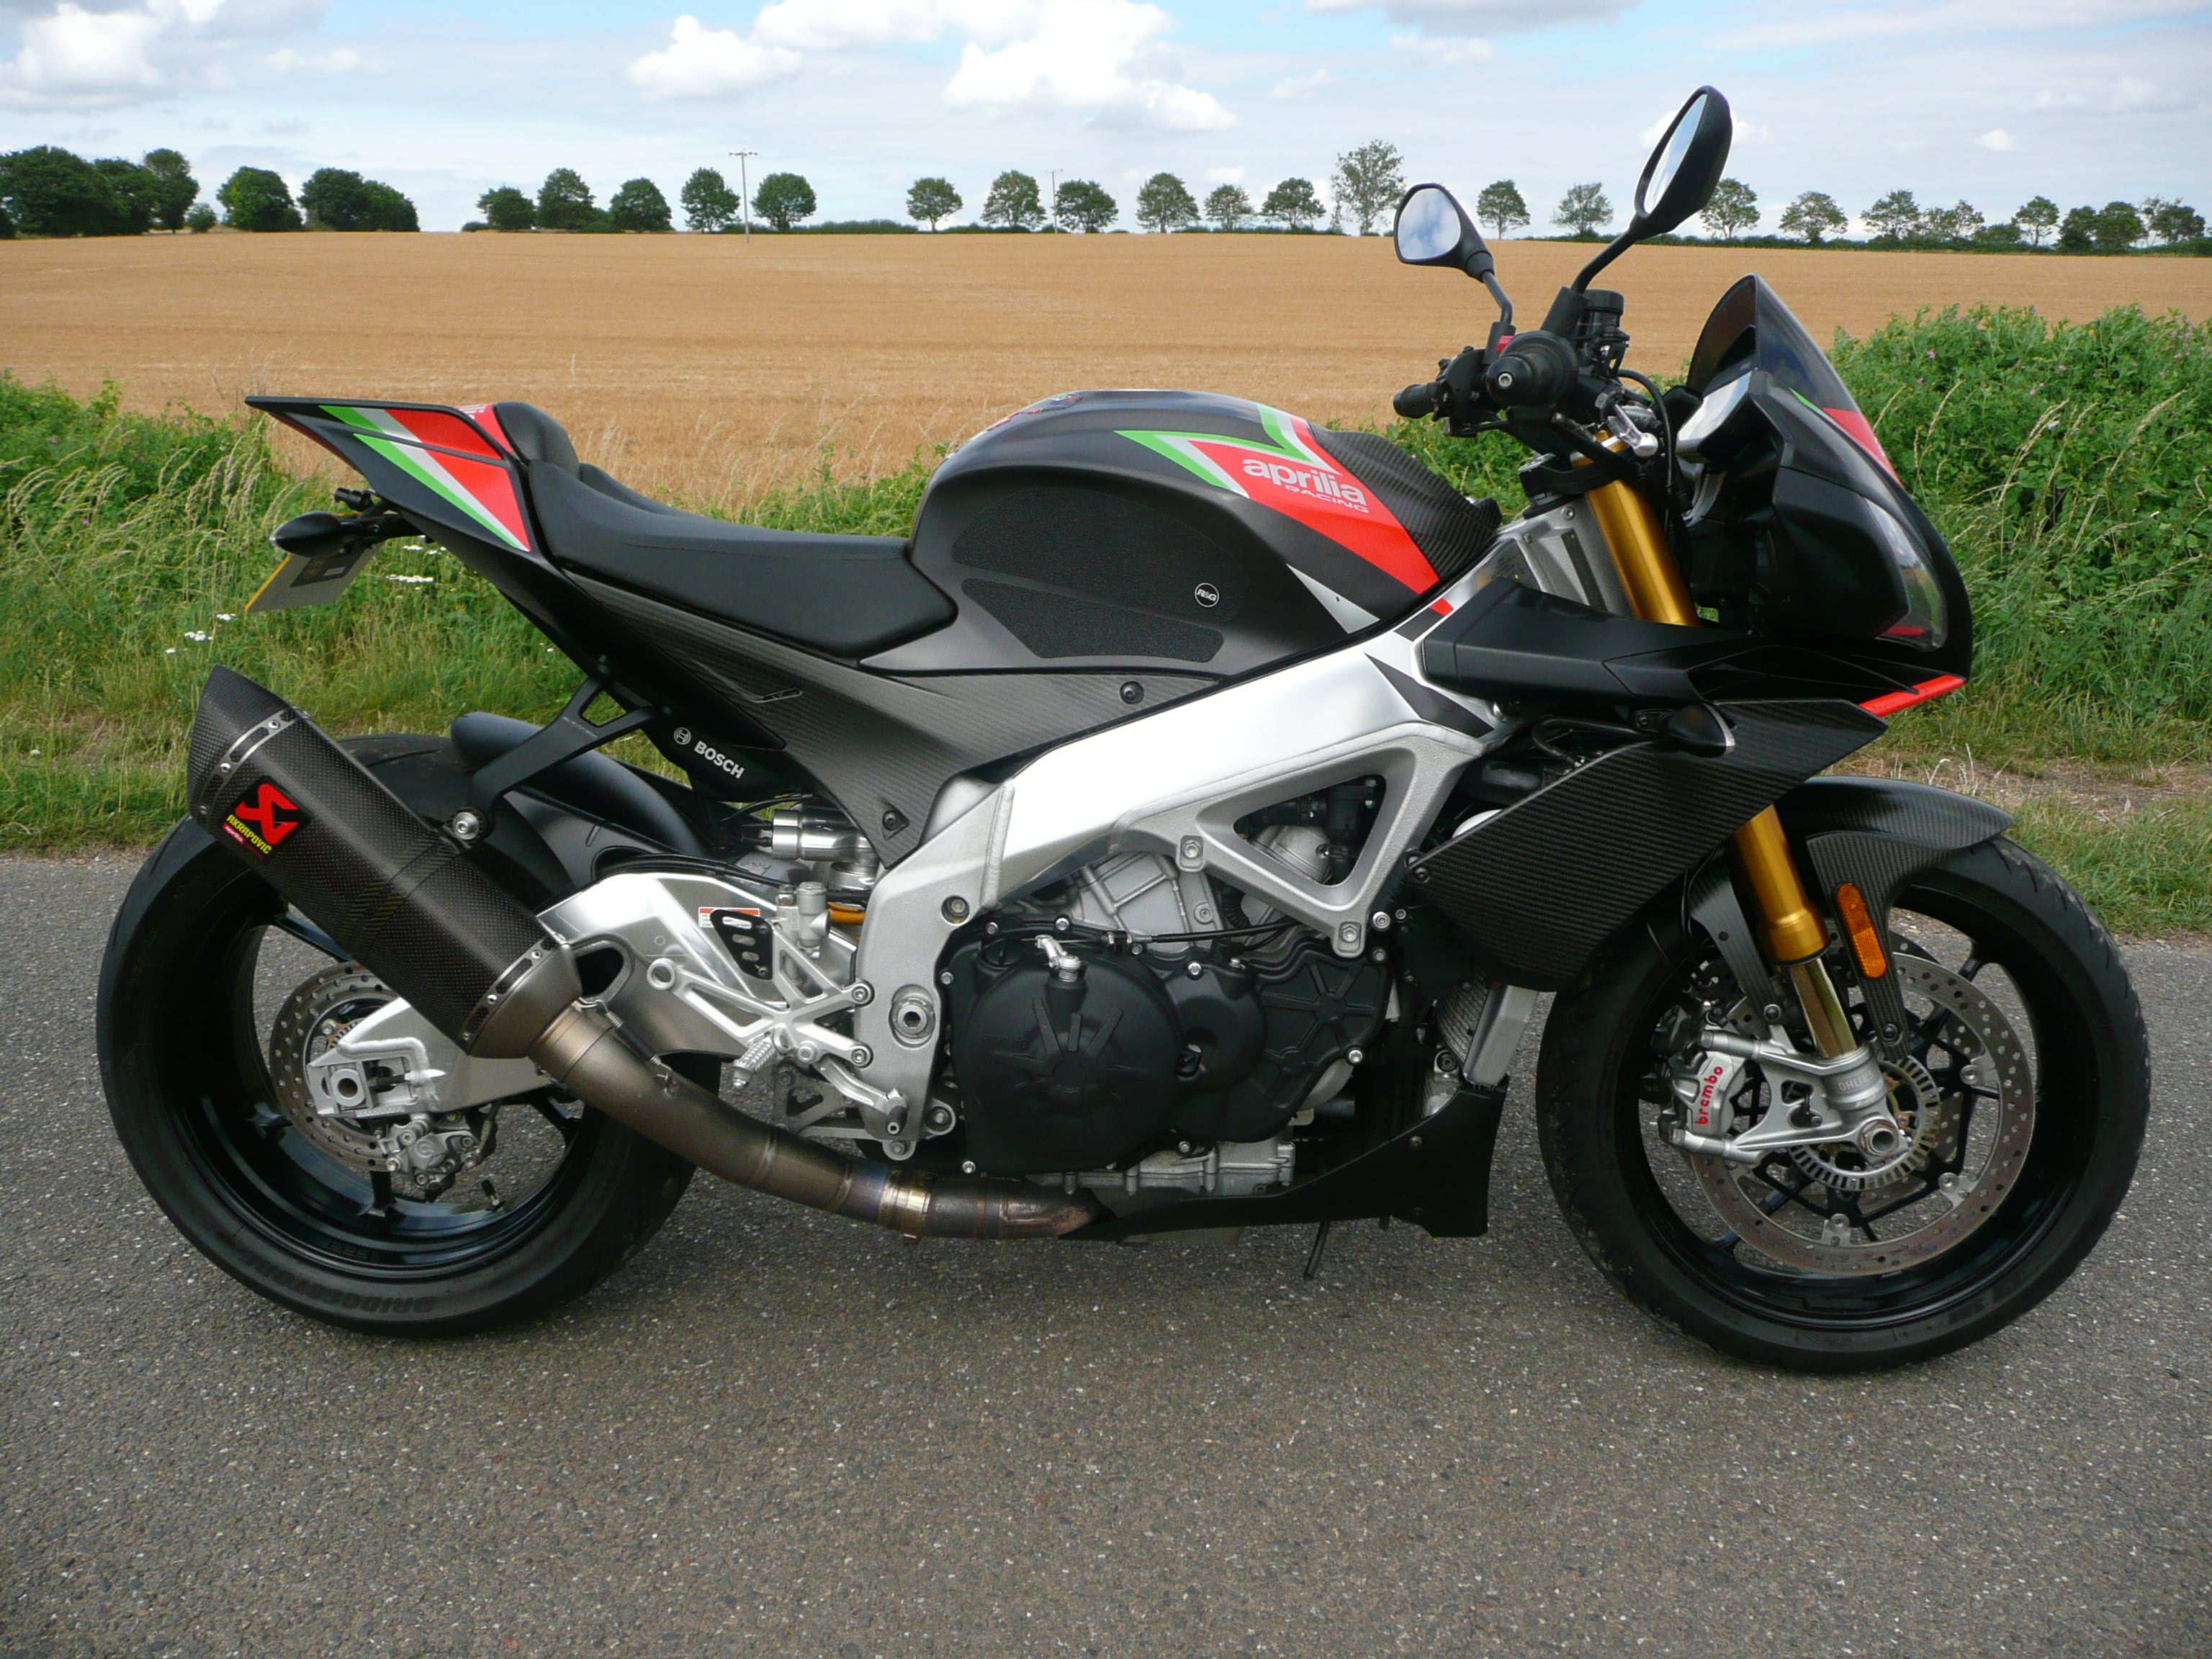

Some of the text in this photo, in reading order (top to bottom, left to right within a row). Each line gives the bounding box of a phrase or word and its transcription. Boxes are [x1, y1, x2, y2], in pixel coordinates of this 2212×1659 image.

[1243, 459, 1367, 506] aprilia
[1285, 484, 1369, 513] RACING
[693, 740, 745, 779] BOSCH
[226, 814, 273, 855] AKRAPOVIC
[1694, 1066, 1724, 1125] brembo
